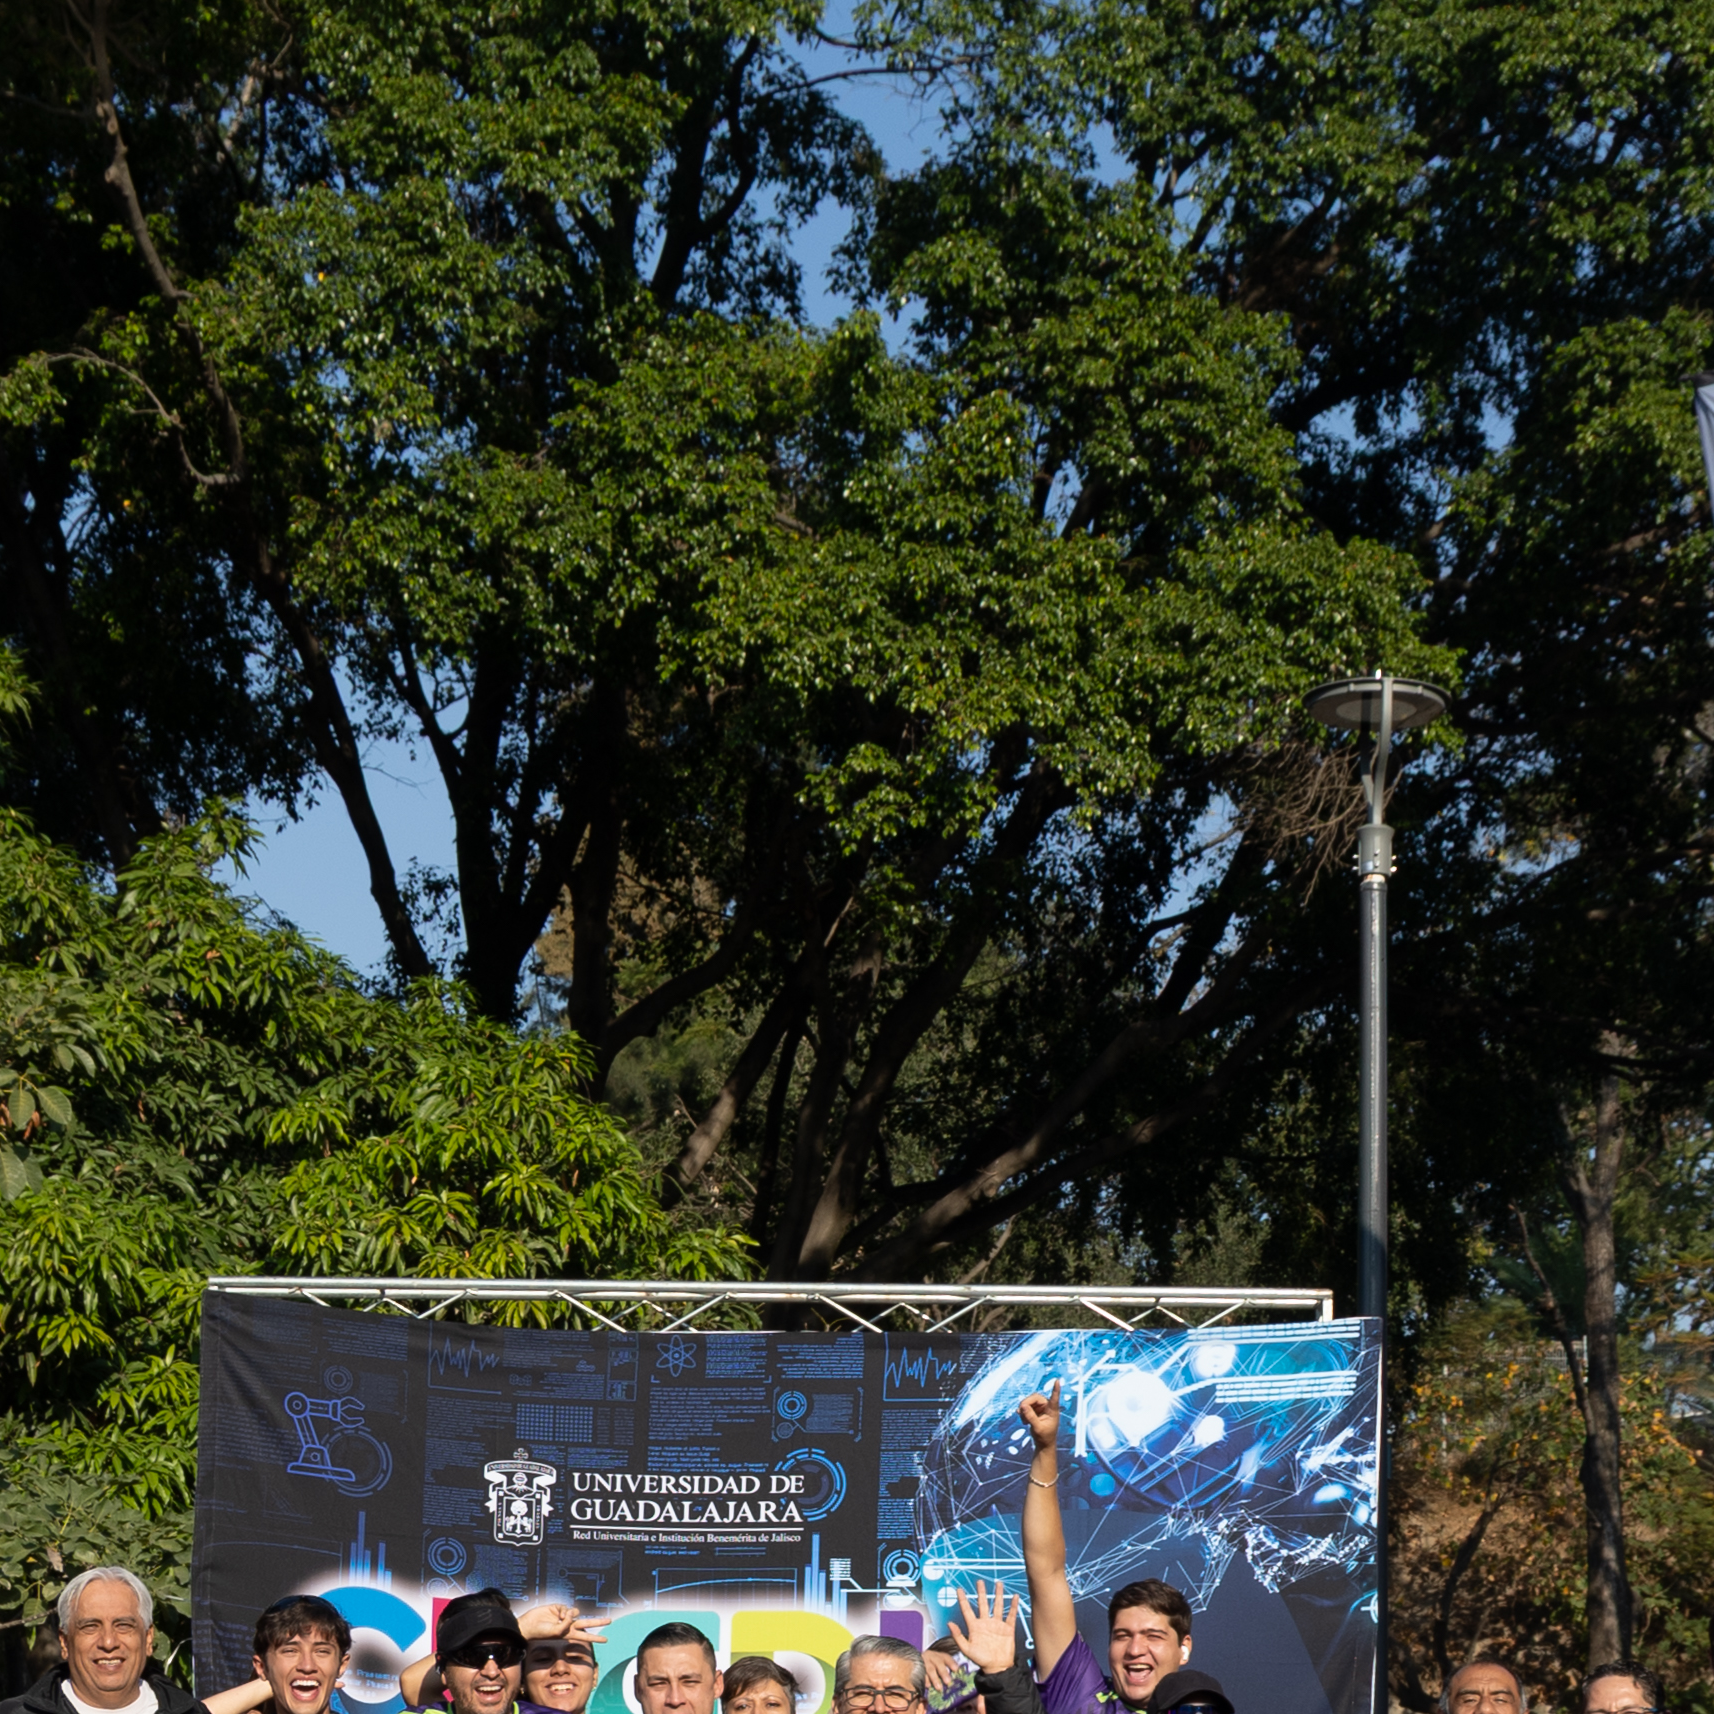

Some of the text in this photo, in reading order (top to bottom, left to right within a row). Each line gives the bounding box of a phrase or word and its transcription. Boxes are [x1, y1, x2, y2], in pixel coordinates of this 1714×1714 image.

[572, 1472, 805, 1495] UNIVERSIDAD DE
[570, 1498, 804, 1523] GUADALAJARA
[573, 1530, 589, 1539] Red
[593, 1530, 649, 1541] Universitaria
[659, 1531, 705, 1542] Institución
[707, 1532, 758, 1543] Benemérita
[760, 1533, 769, 1542] de
[771, 1532, 801, 1545] Jalisco
